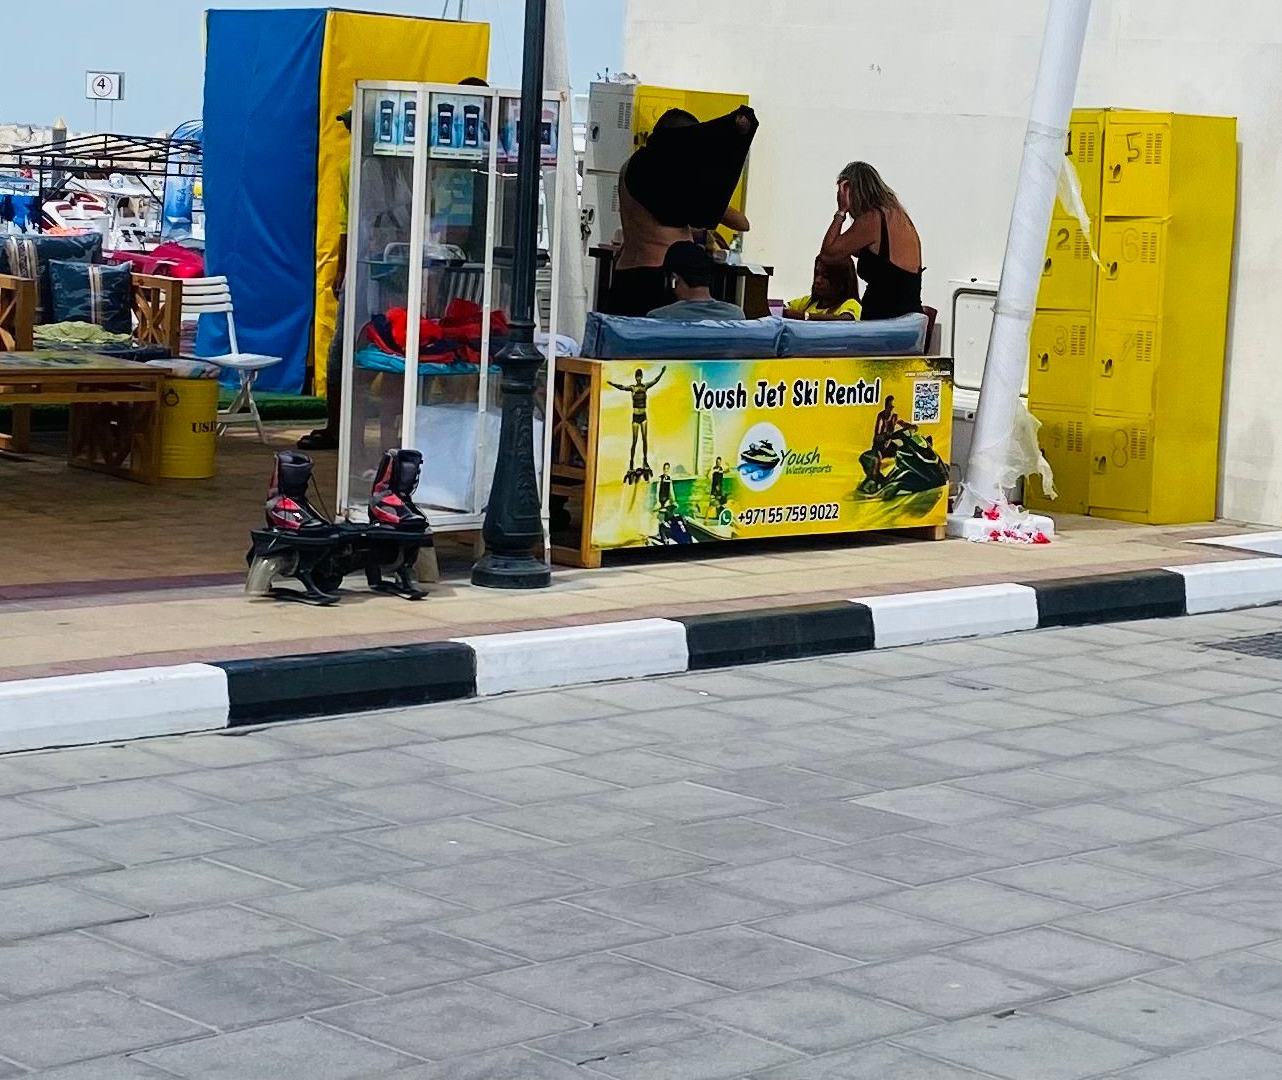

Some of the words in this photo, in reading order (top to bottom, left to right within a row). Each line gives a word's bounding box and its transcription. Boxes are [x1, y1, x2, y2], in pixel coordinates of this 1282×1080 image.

[97, 77, 106, 90] 4
[1126, 132, 1142, 163] 5
[1056, 228, 1070, 250] 2
[1122, 228, 1139, 263] 6
[1053, 325, 1067, 356] 3
[692, 382, 747, 410] Yoush
[754, 381, 787, 408] Jet
[792, 379, 819, 407] Ski
[825, 378, 880, 406] Rental
[779, 446, 821, 466] Yoush
[1112, 428, 1129, 469] 8
[785, 464, 833, 477] Watersports
[738, 508, 766, 525] +971
[768, 507, 783, 523] 55
[785, 505, 807, 522] 759
[809, 503, 839, 520] 9022
